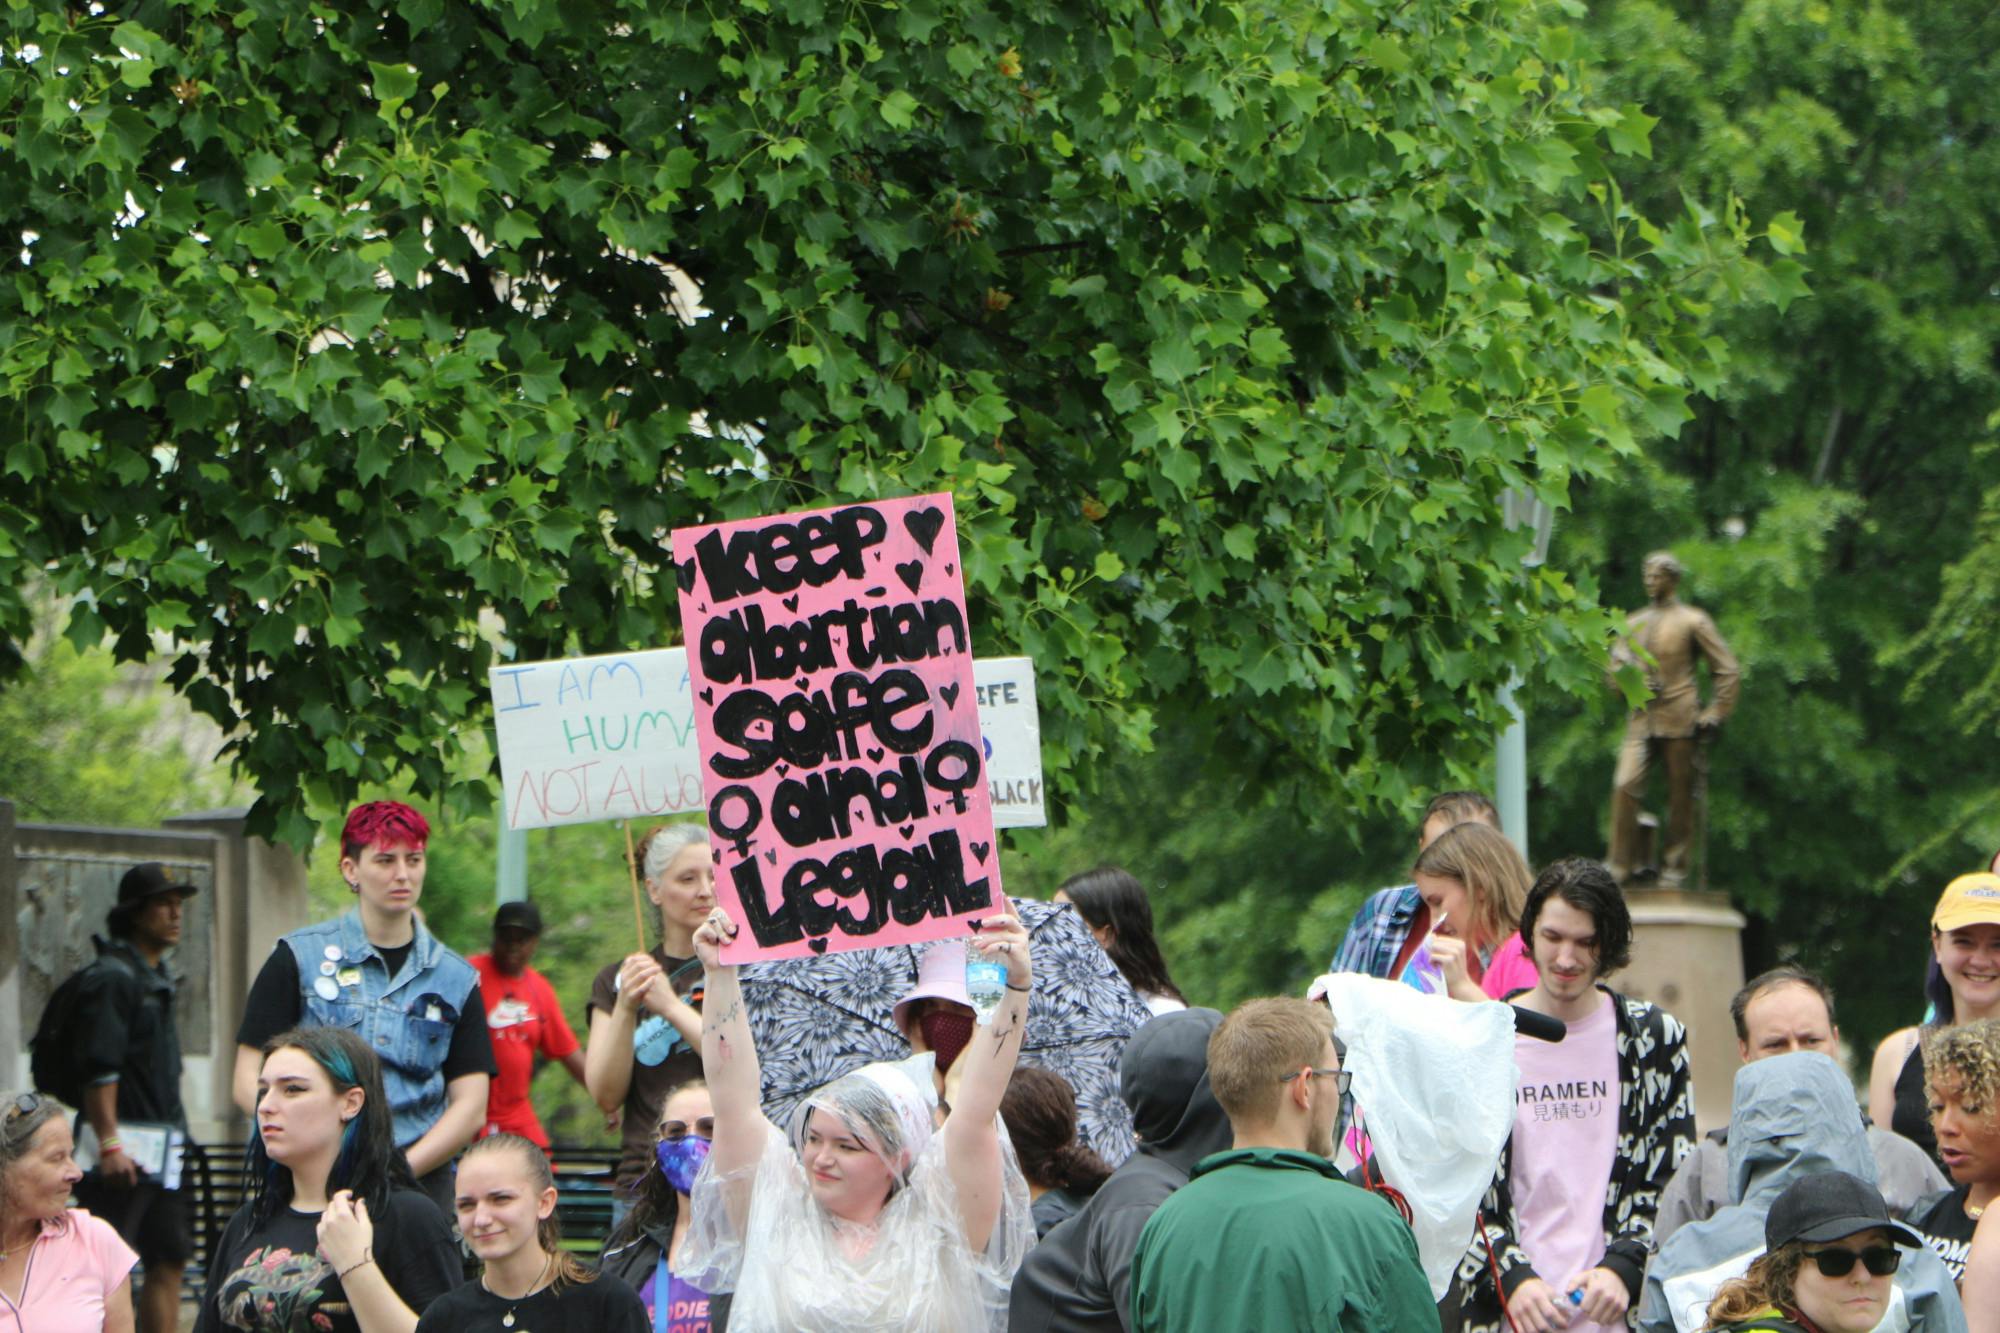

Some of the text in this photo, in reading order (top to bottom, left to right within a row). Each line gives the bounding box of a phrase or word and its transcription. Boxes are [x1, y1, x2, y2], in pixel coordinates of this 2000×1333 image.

[700, 586, 966, 684] abortion
[497, 667, 541, 712] I
[558, 661, 644, 705] AM
[512, 761, 601, 828] NOT
[771, 756, 928, 847] and
[1534, 1101, 1603, 1122] 見積もり
